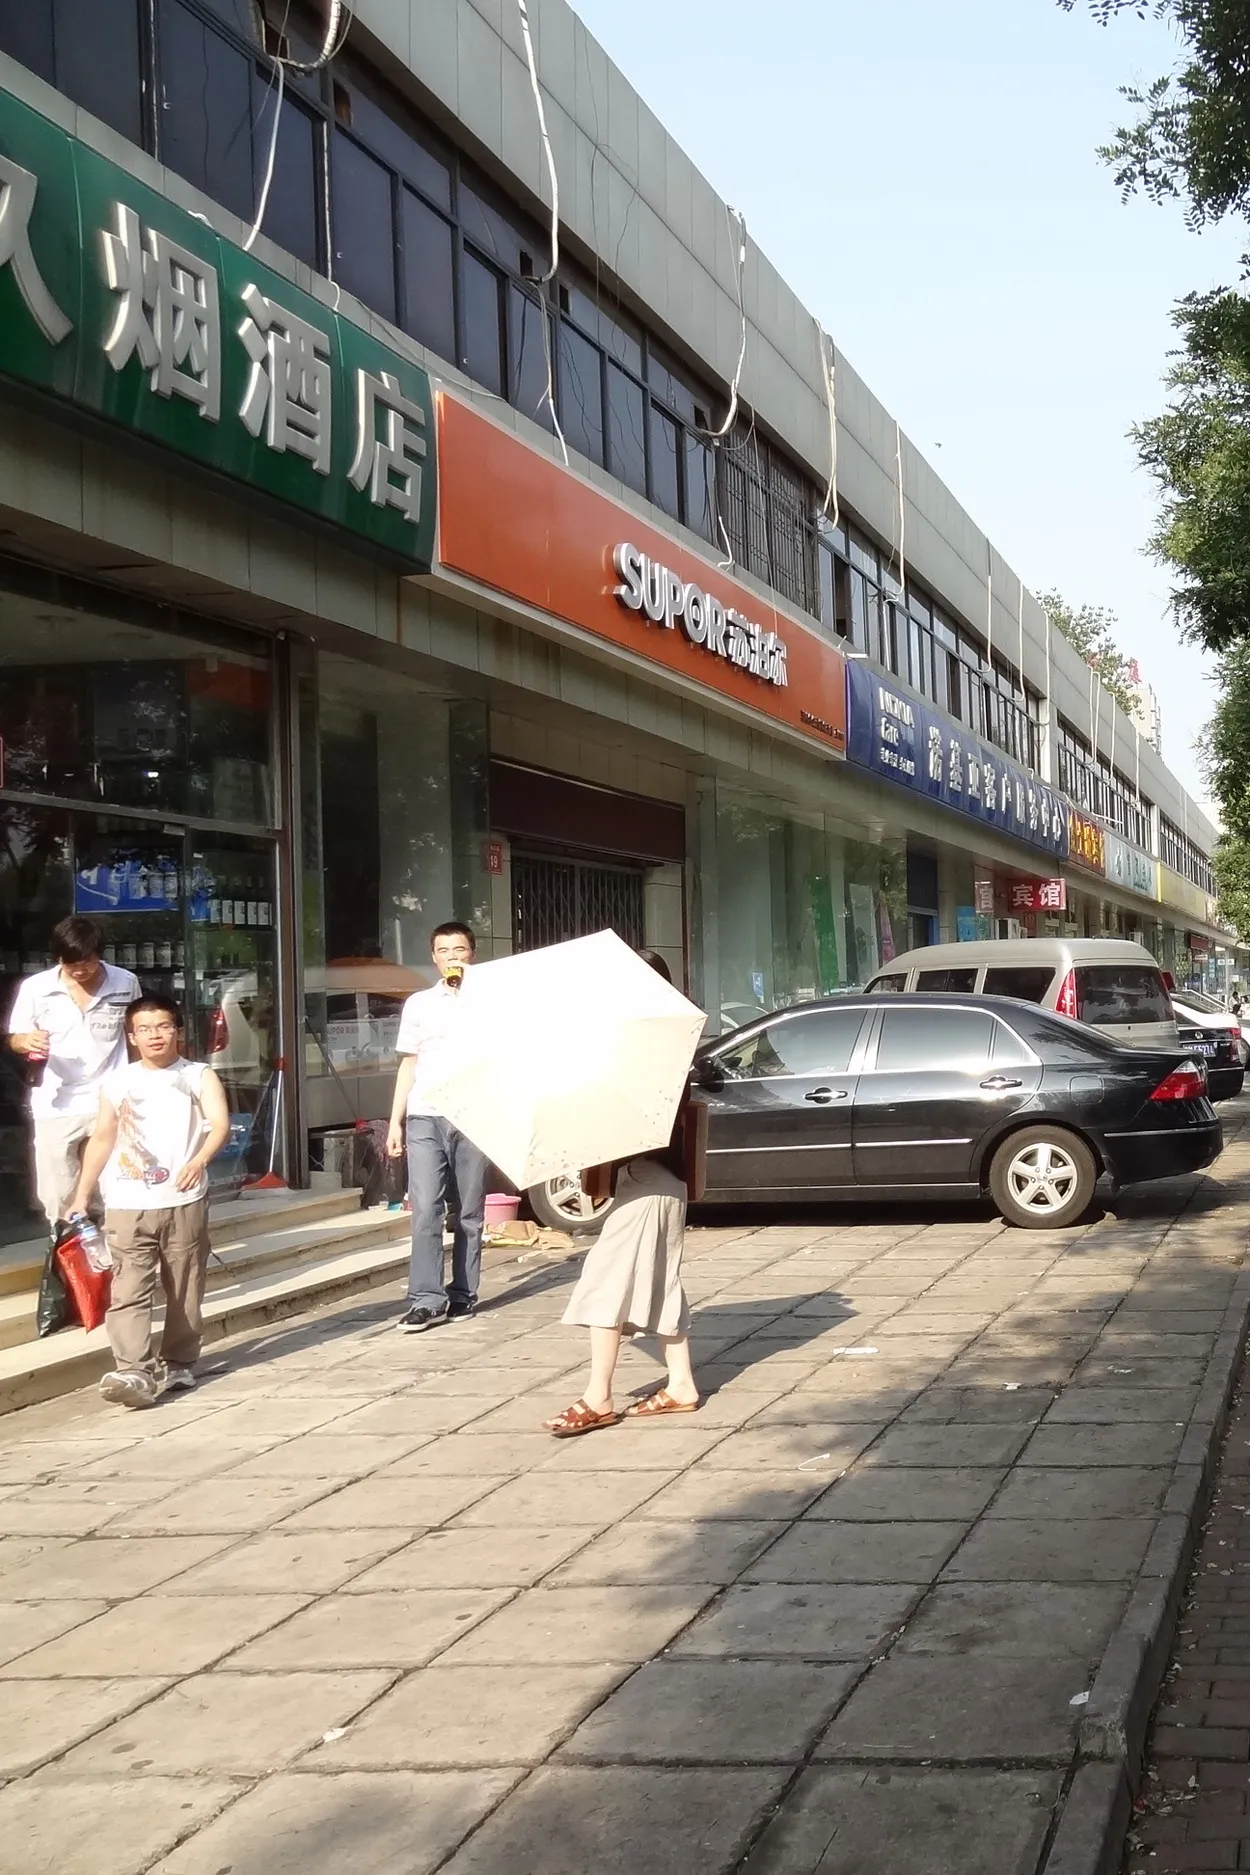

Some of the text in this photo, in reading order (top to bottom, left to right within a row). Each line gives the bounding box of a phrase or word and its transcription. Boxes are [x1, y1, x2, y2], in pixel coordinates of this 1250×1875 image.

[613, 542, 789, 687] SUPOR 苏泊尔
[1012, 883, 1061, 907] 宾馆
